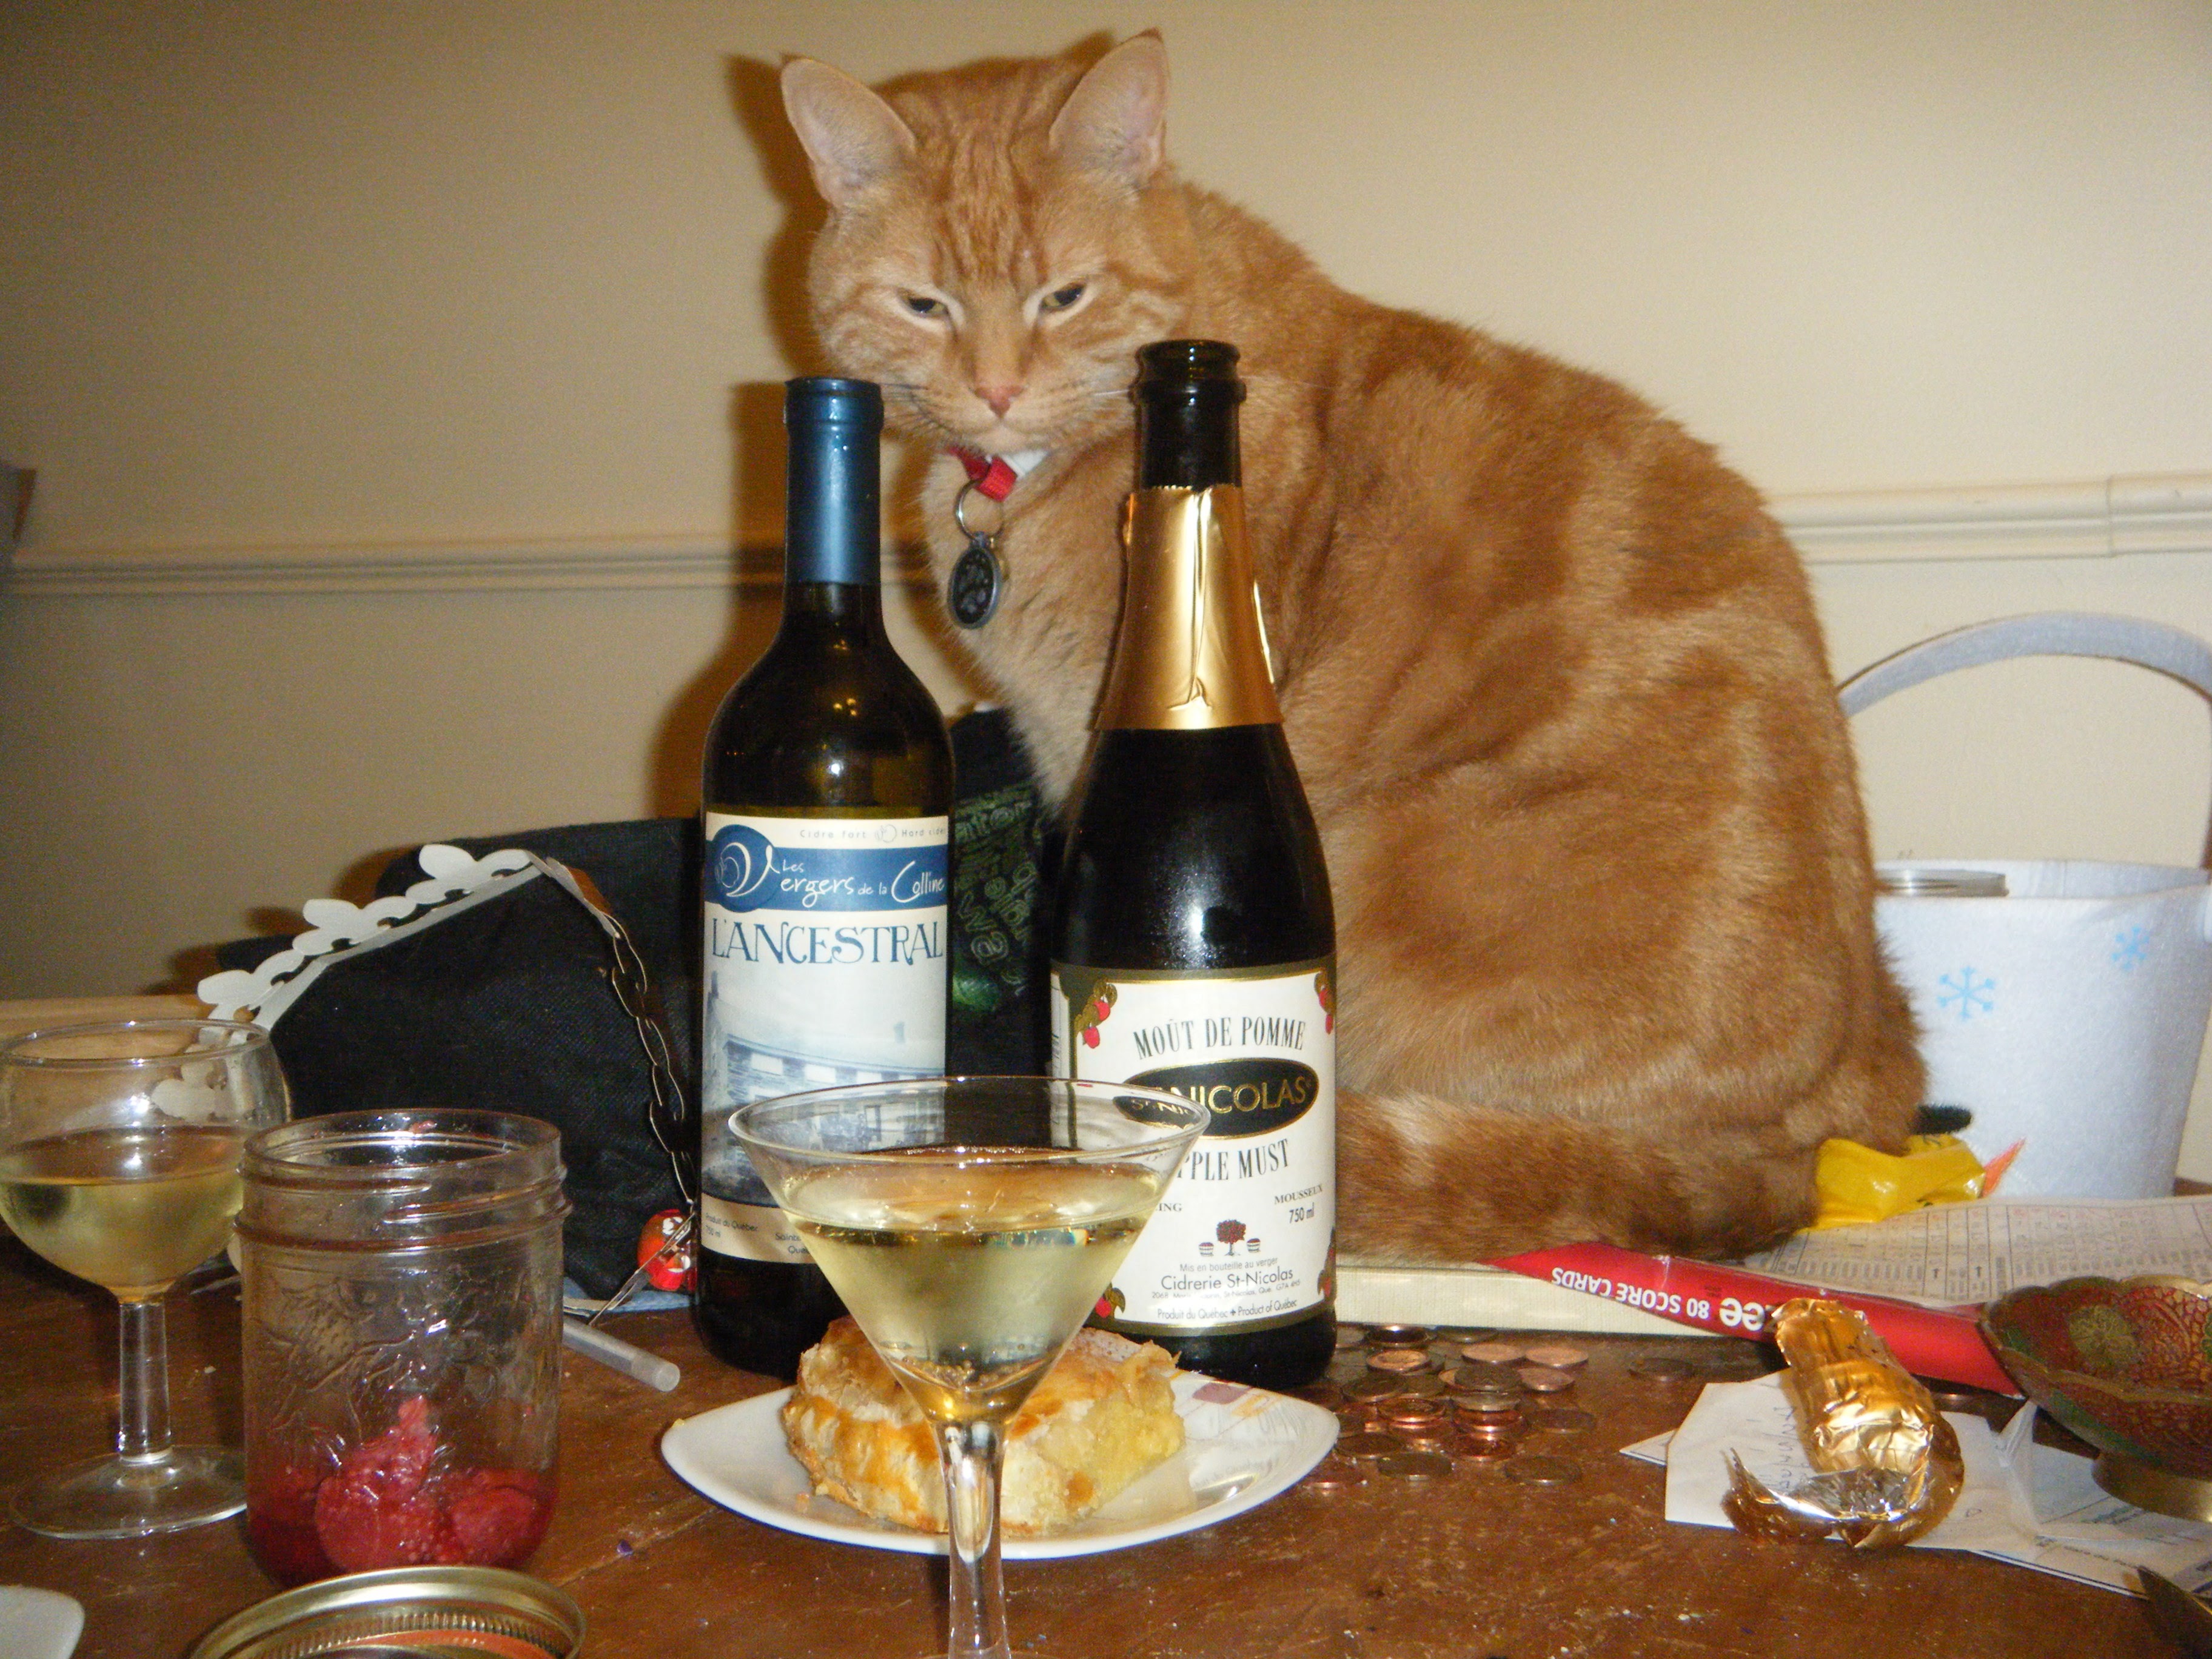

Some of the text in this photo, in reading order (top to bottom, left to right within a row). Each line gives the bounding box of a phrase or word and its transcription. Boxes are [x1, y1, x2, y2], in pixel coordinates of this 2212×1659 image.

[800, 830, 866, 839] Cidre fort
[902, 827, 945, 837] Hard cide
[783, 859, 804, 873] Les
[857, 883, 874, 895] de
[879, 882, 888, 895] la
[891, 860, 945, 903] Colline
[712, 918, 943, 965] L'ANCESTRAL
[1133, 1016, 1307, 1060] MOÛT DE POMME
[1178, 1138, 1289, 1181] PLE MUST
[1289, 1207, 1304, 1224] 750
[1180, 1263, 1195, 1272] Mis
[1209, 1261, 1242, 1272] bouteille
[1256, 1257, 1278, 1267] verger
[1161, 1265, 1293, 1290] Cidrerie St-Nicolas
[1551, 1267, 1612, 1298] CARDS
[1158, 1308, 1184, 1319] Produit
[1186, 1308, 1196, 1319] du
[1238, 1303, 1264, 1316] Product
[1265, 1299, 1273, 1313] of
[1616, 1282, 1681, 1313] SCORE
[1686, 1297, 1711, 1319] 80
